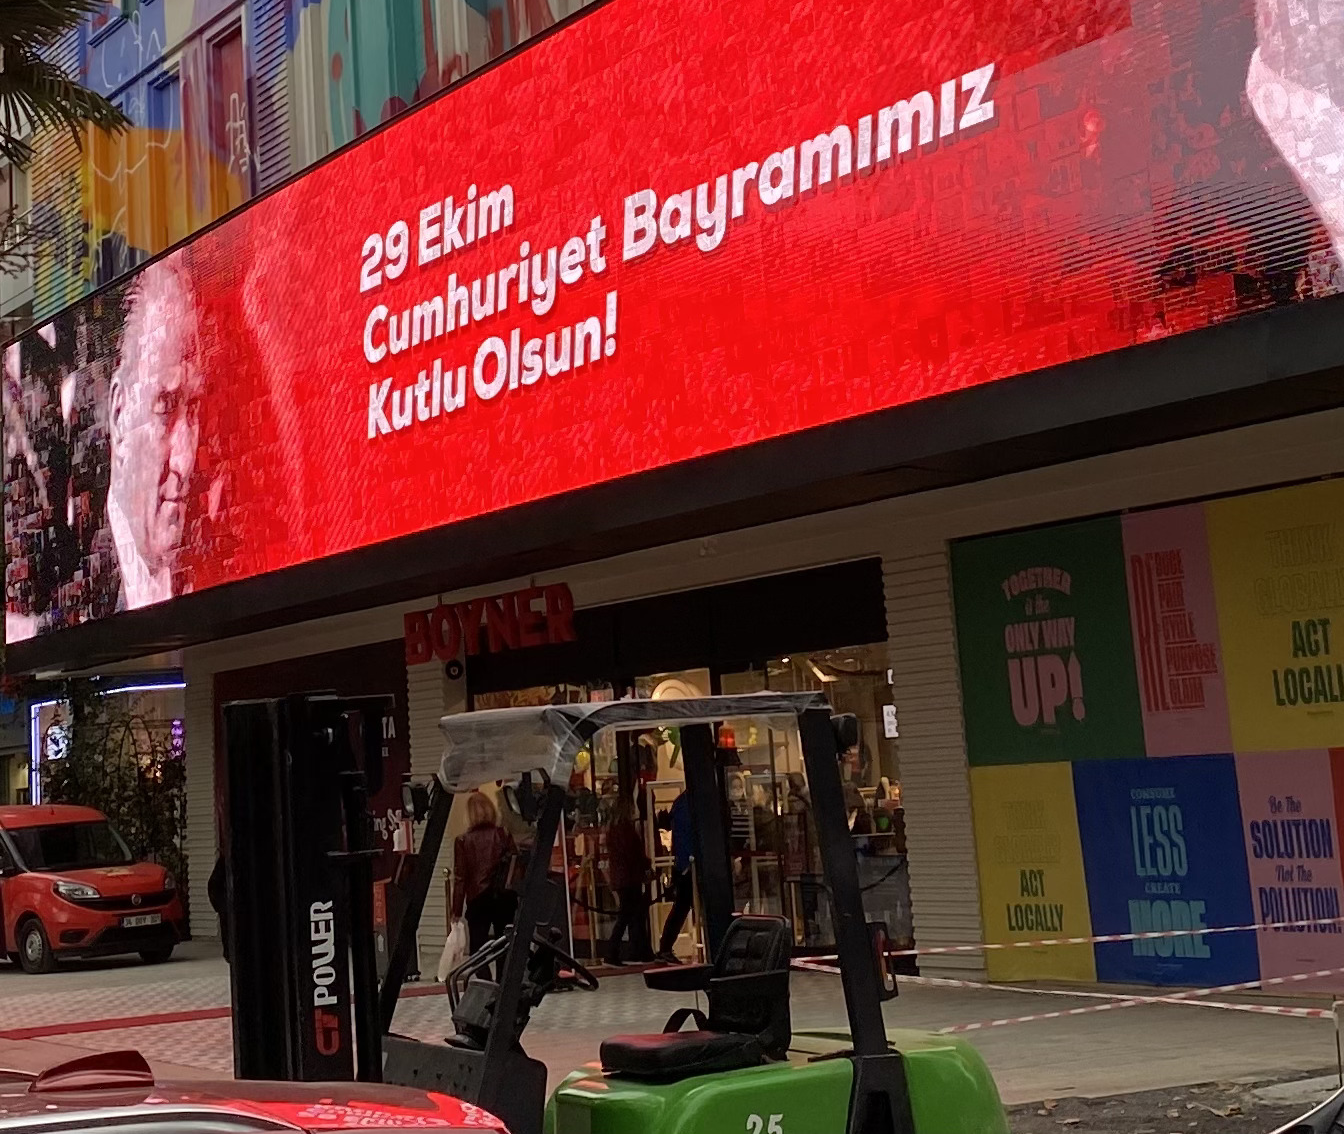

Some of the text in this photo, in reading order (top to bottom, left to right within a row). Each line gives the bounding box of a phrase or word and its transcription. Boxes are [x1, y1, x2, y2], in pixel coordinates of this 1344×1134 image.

[358, 180, 515, 294] 29 Ekim
[361, 213, 608, 365] Cumhuriyet
[366, 290, 619, 441] Kutlu Olsun!
[1001, 566, 1072, 601] TOGETHER
[403, 581, 577, 666] BOYNER
[1004, 616, 1075, 653] ONLY WAY
[1291, 618, 1331, 658] ACT
[1164, 642, 1218, 673] PURPOSE
[1007, 649, 1086, 726] UP!
[1285, 794, 1303, 814] The
[1129, 804, 1189, 877] LESS
[1249, 817, 1335, 860] SOLUTION
[1019, 869, 1046, 898] ACT
[1144, 882, 1182, 895] CREATE
[1295, 863, 1313, 883] The
[1006, 904, 1064, 933] LOCALLY
[1127, 899, 1212, 959] MORE
[310, 900, 338, 1007] POWER
